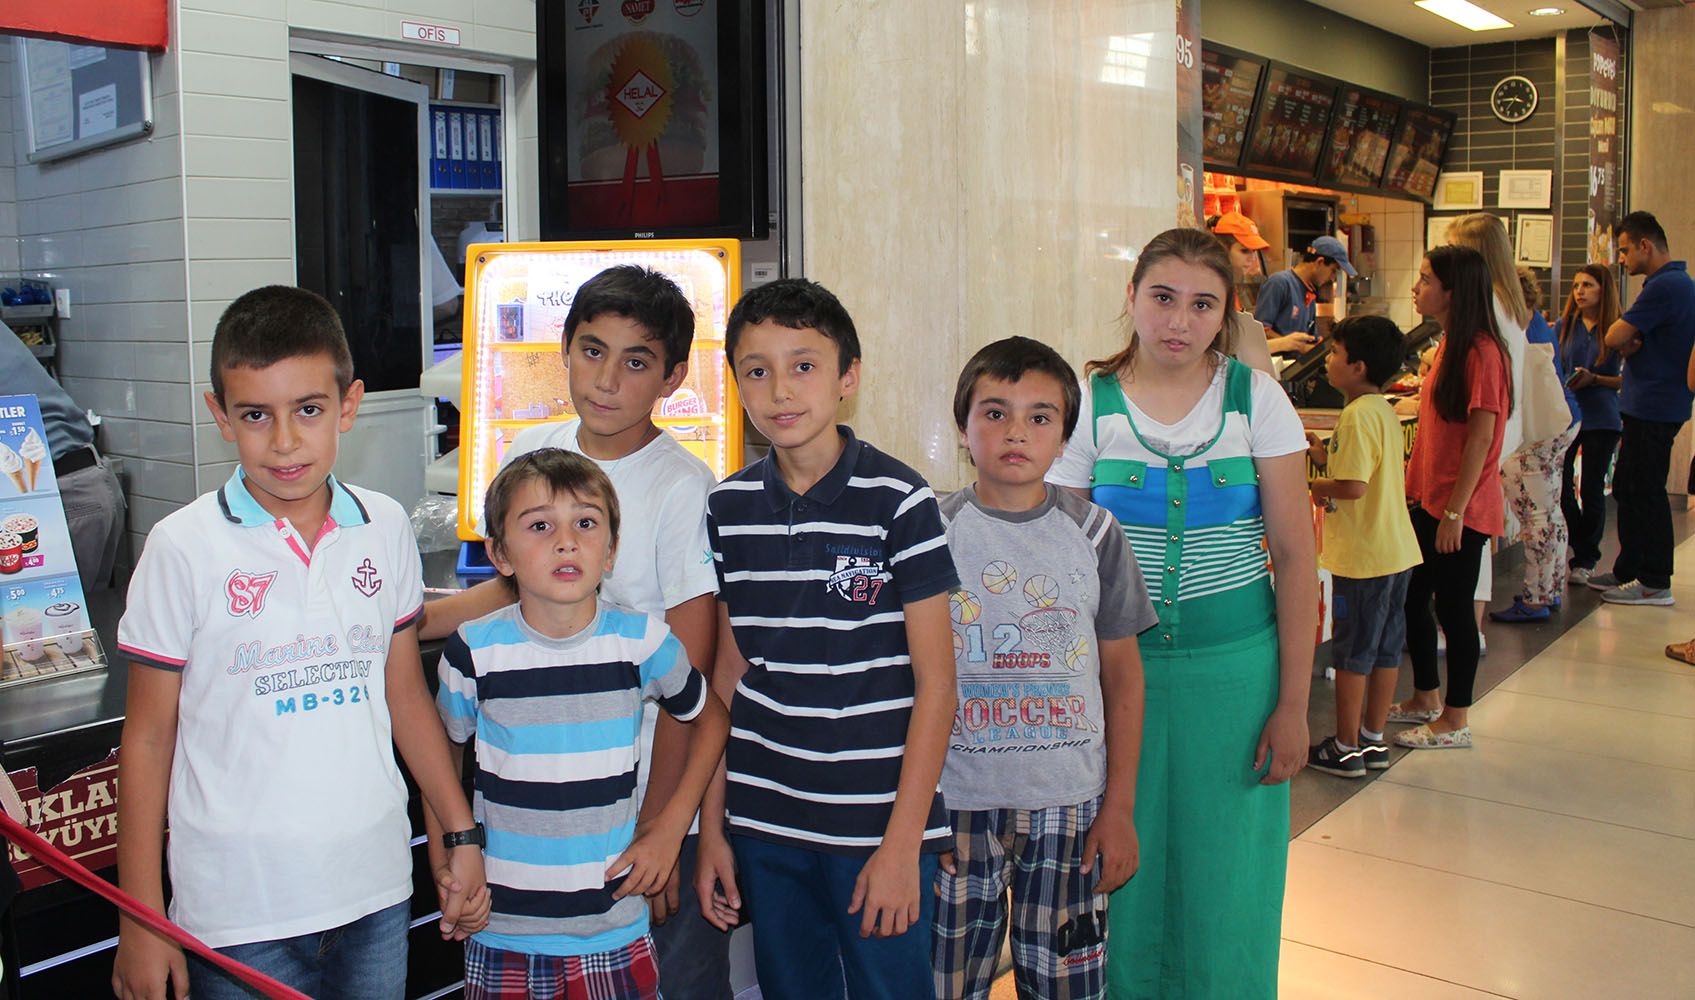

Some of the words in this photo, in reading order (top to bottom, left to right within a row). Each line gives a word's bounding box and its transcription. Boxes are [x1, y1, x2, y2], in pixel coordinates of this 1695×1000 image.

[623, 85, 658, 100] HELAL
[634, 231, 655, 239] PHILIPS
[825, 543, 883, 557] Saildivisio
[226, 572, 276, 616] 87
[853, 575, 883, 605] 27
[965, 623, 1023, 663] 12
[228, 634, 339, 675] Marine
[992, 653, 1051, 669] HOOPS
[961, 683, 1020, 698] WOMEN'S
[971, 726, 1070, 744] LEAGUE
[950, 738, 1092, 754] CHAMPIONSHIP
[23, 778, 118, 826] KLA
